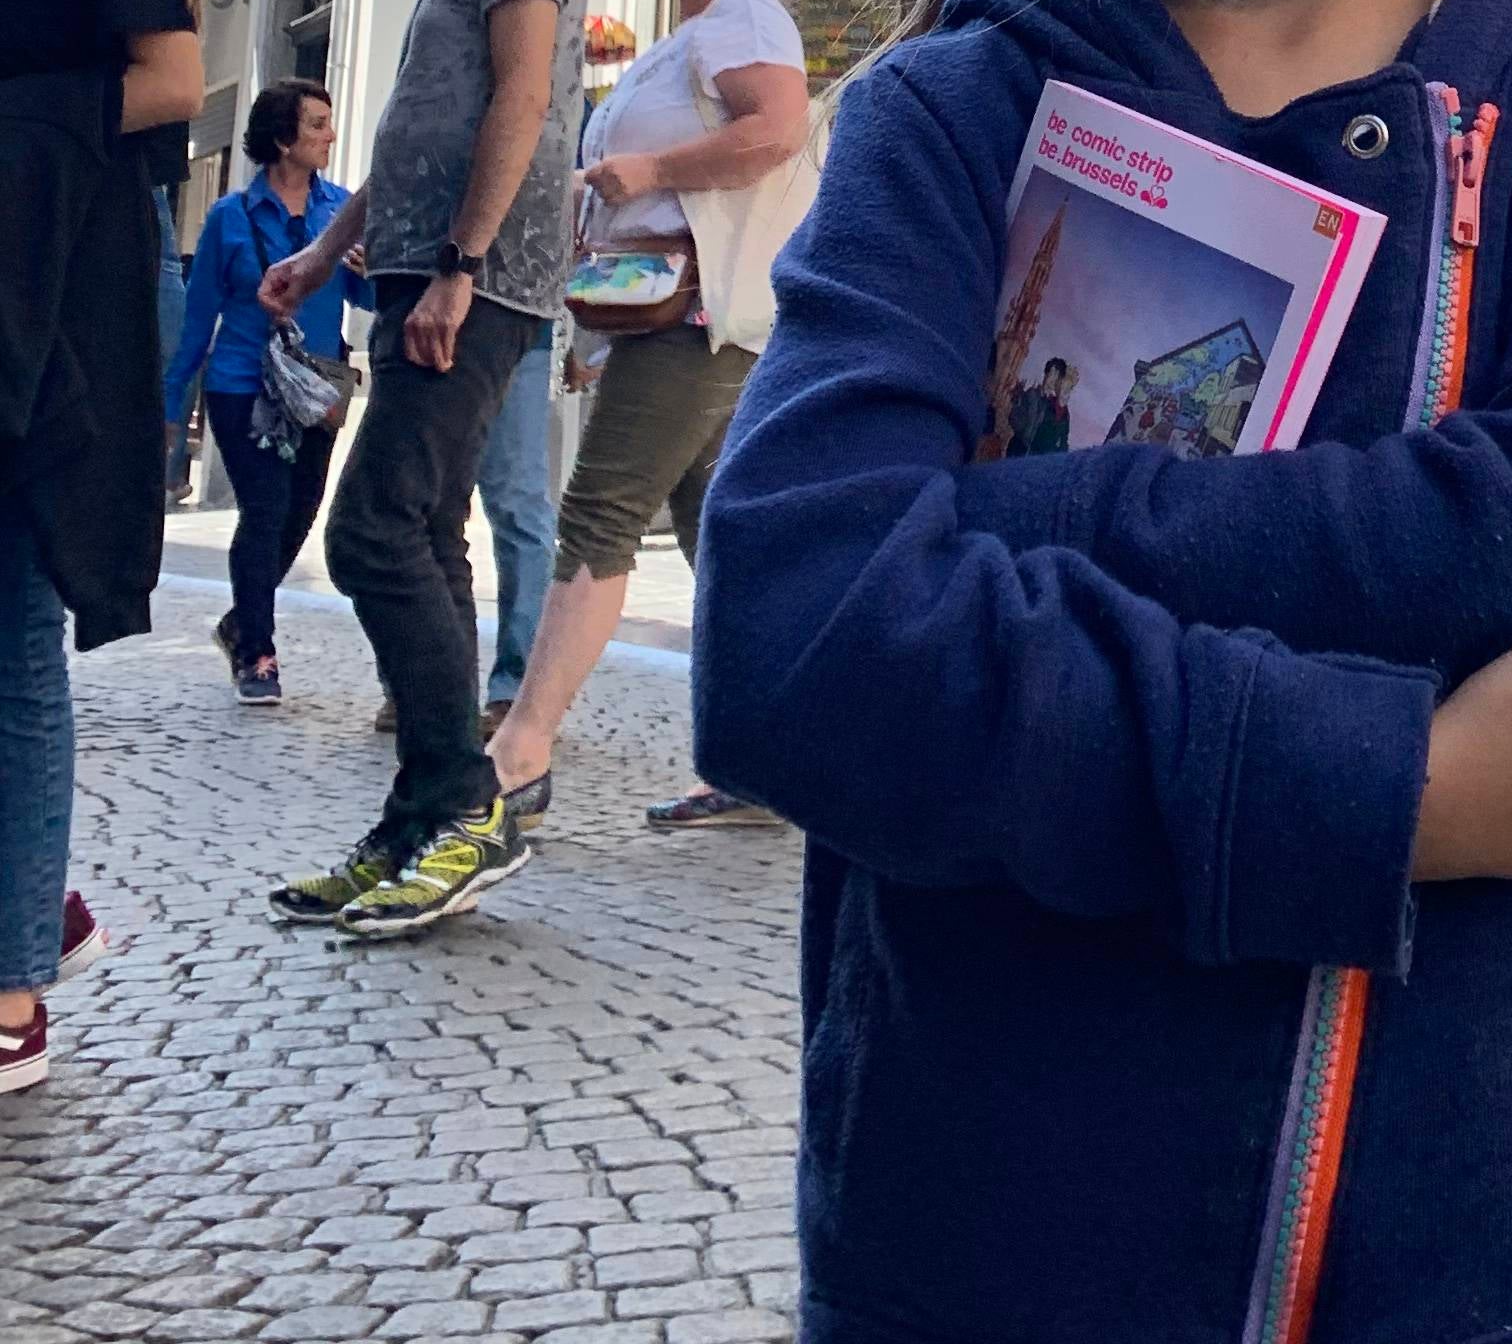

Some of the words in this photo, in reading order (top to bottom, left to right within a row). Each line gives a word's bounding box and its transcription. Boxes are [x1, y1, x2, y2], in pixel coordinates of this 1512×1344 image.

[1038, 133, 1138, 197] be.brussels
[1047, 109, 1067, 135] be
[1071, 126, 1126, 162] comic
[1127, 151, 1173, 184] strip
[1318, 210, 1340, 232] EN
